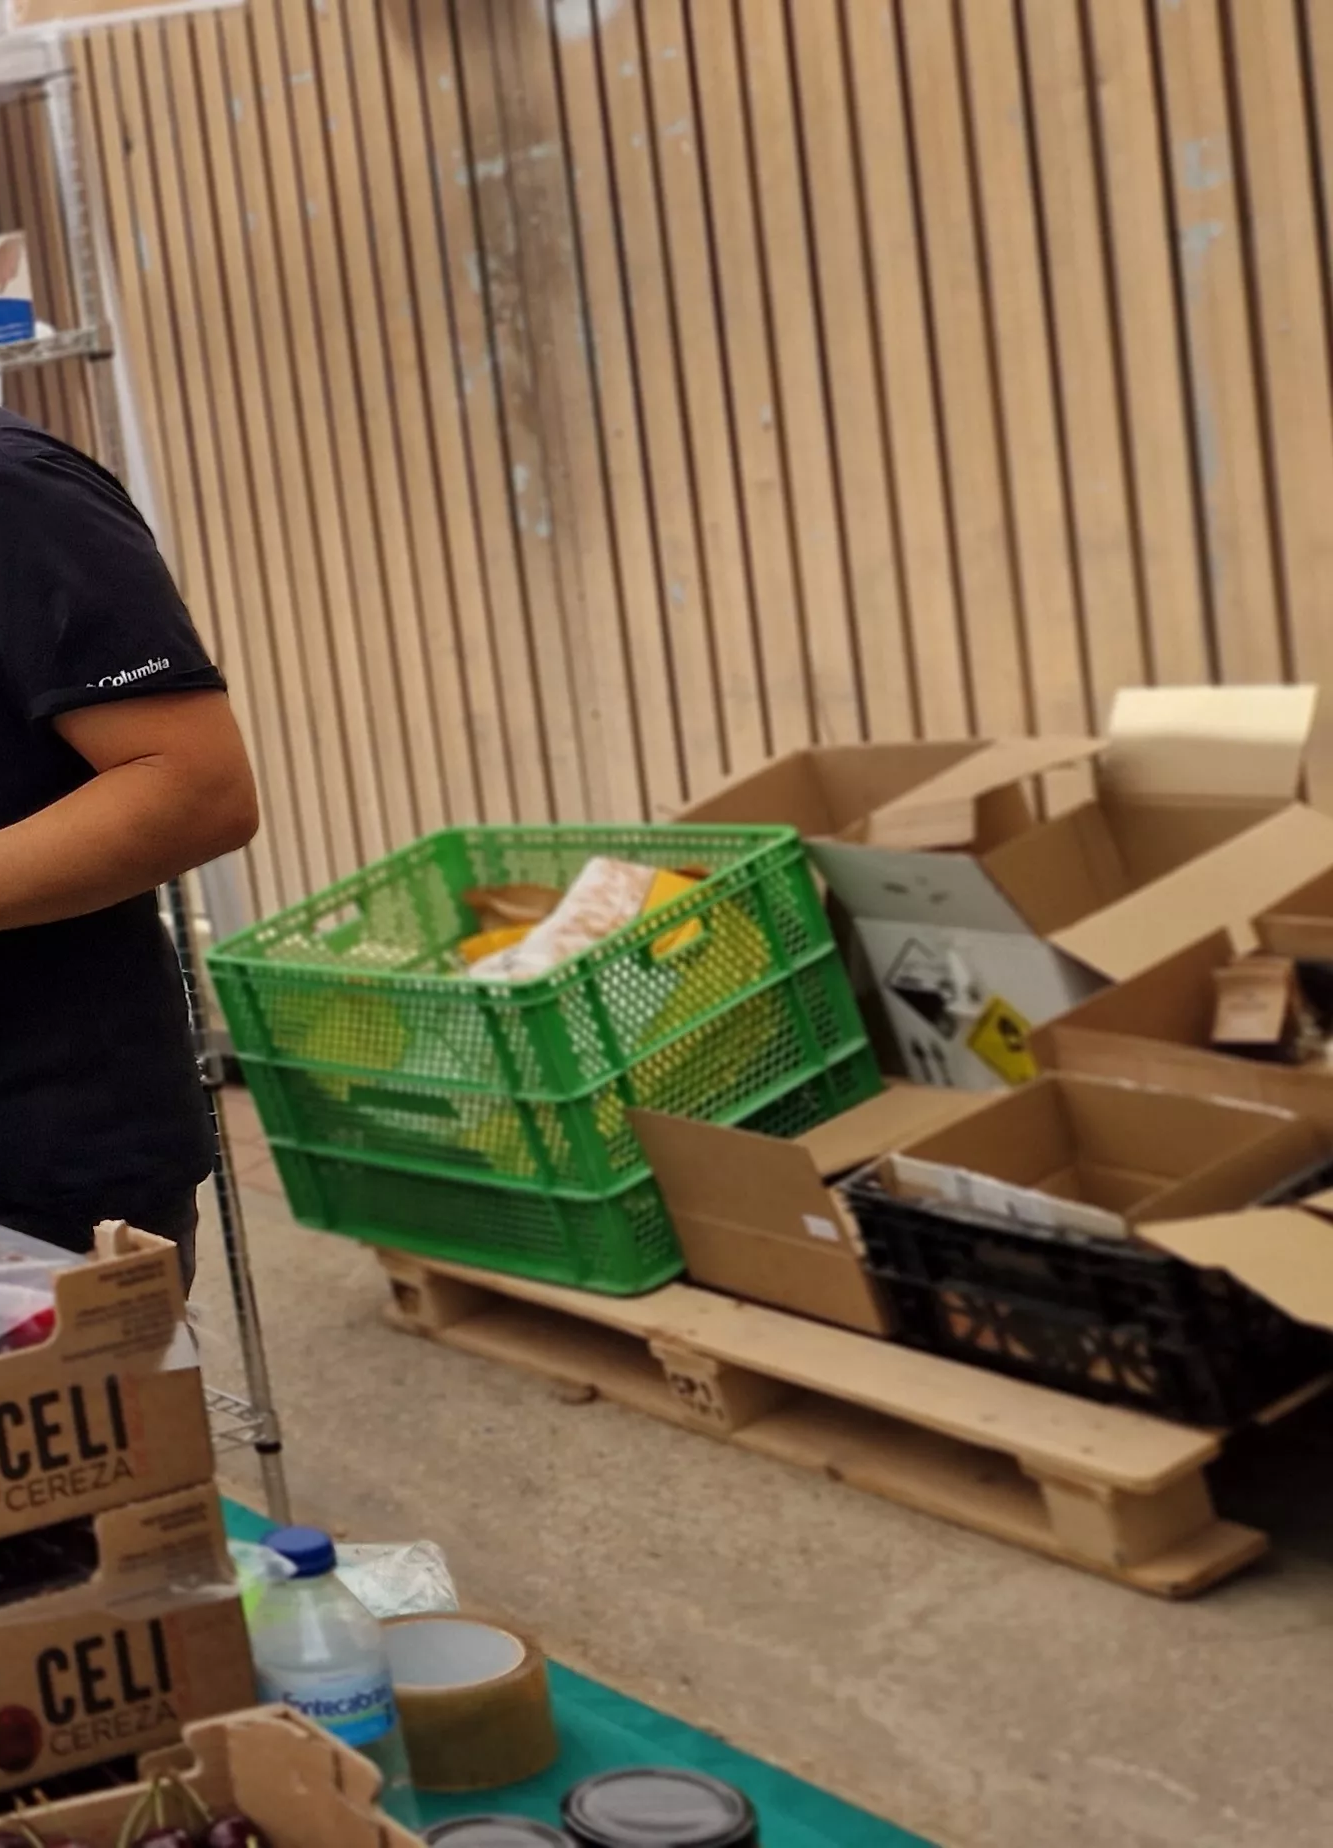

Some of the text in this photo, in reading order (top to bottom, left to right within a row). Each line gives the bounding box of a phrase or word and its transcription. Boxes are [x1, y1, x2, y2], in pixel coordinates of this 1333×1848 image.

[4, 1456, 135, 1513] CEREZA
[37, 1616, 173, 1726] CELI
[49, 1700, 178, 1756] CEREZA
